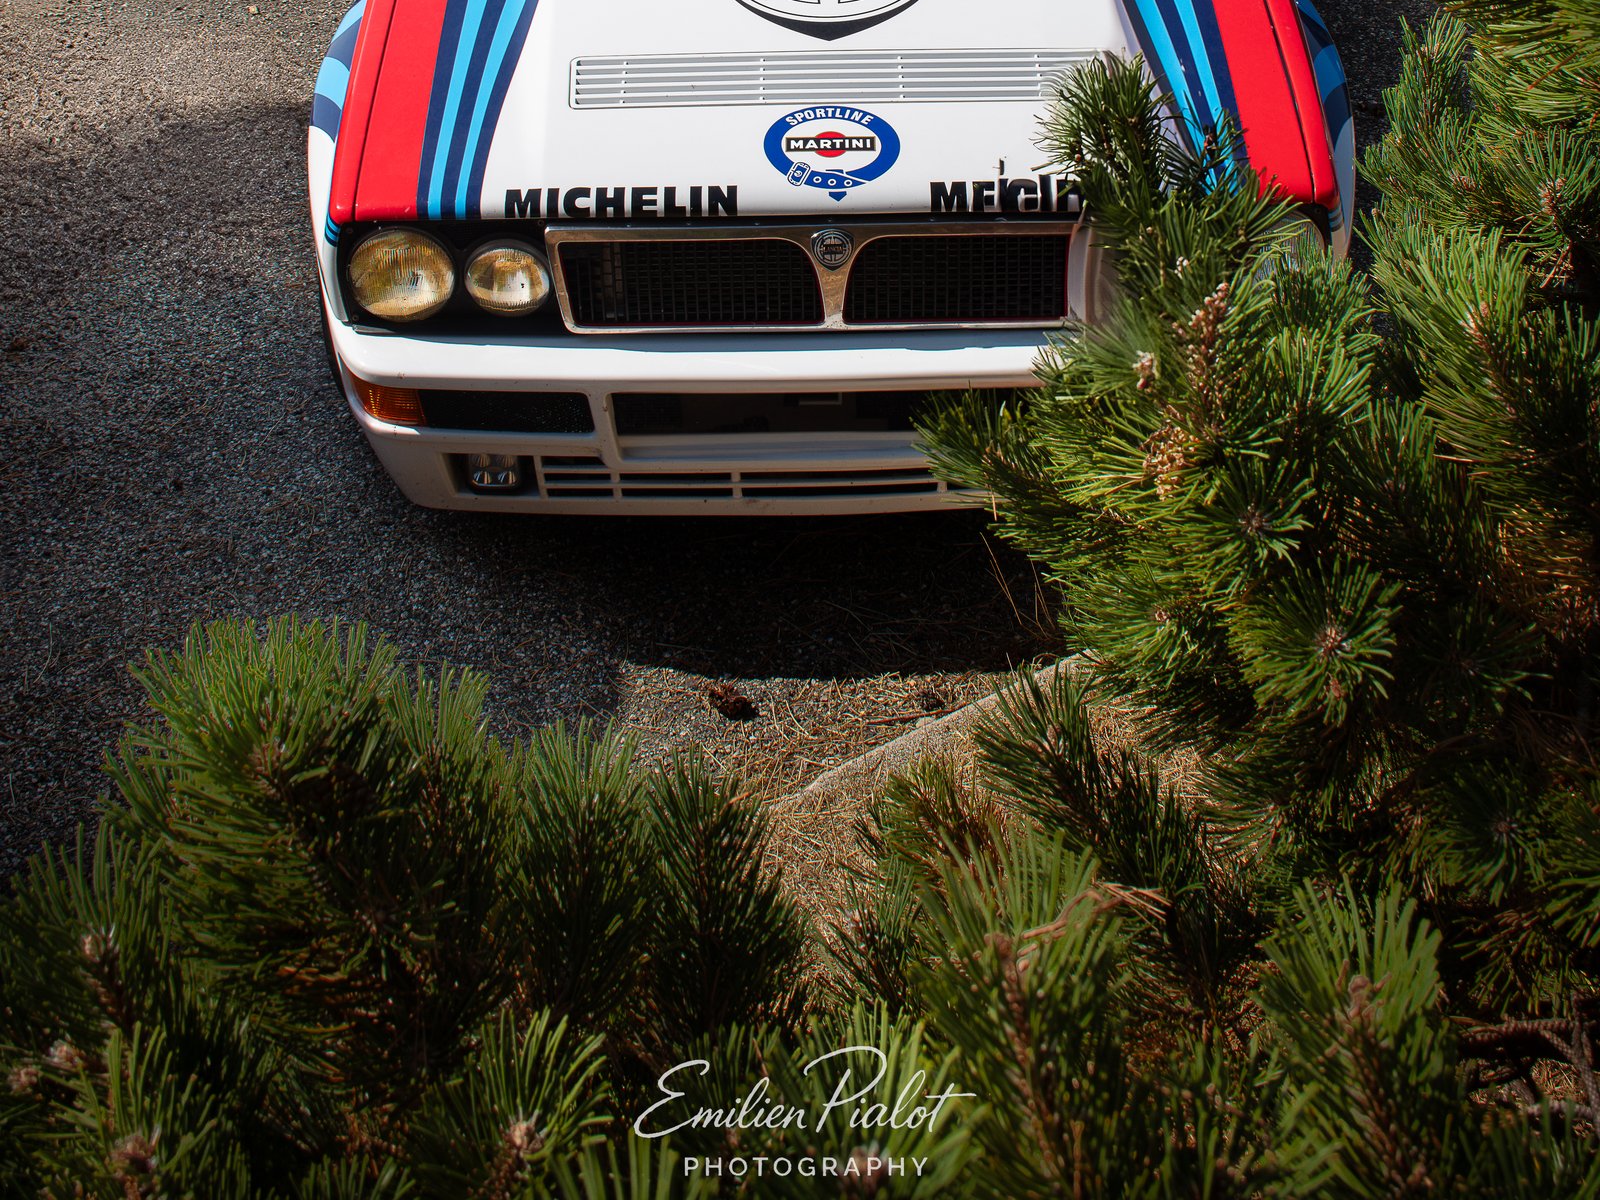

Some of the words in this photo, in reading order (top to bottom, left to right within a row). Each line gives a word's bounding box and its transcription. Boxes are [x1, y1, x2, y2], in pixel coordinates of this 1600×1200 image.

[786, 107, 874, 126] SPORTLINE
[790, 138, 871, 149] MARTINI
[504, 185, 738, 218] MICHELIN
